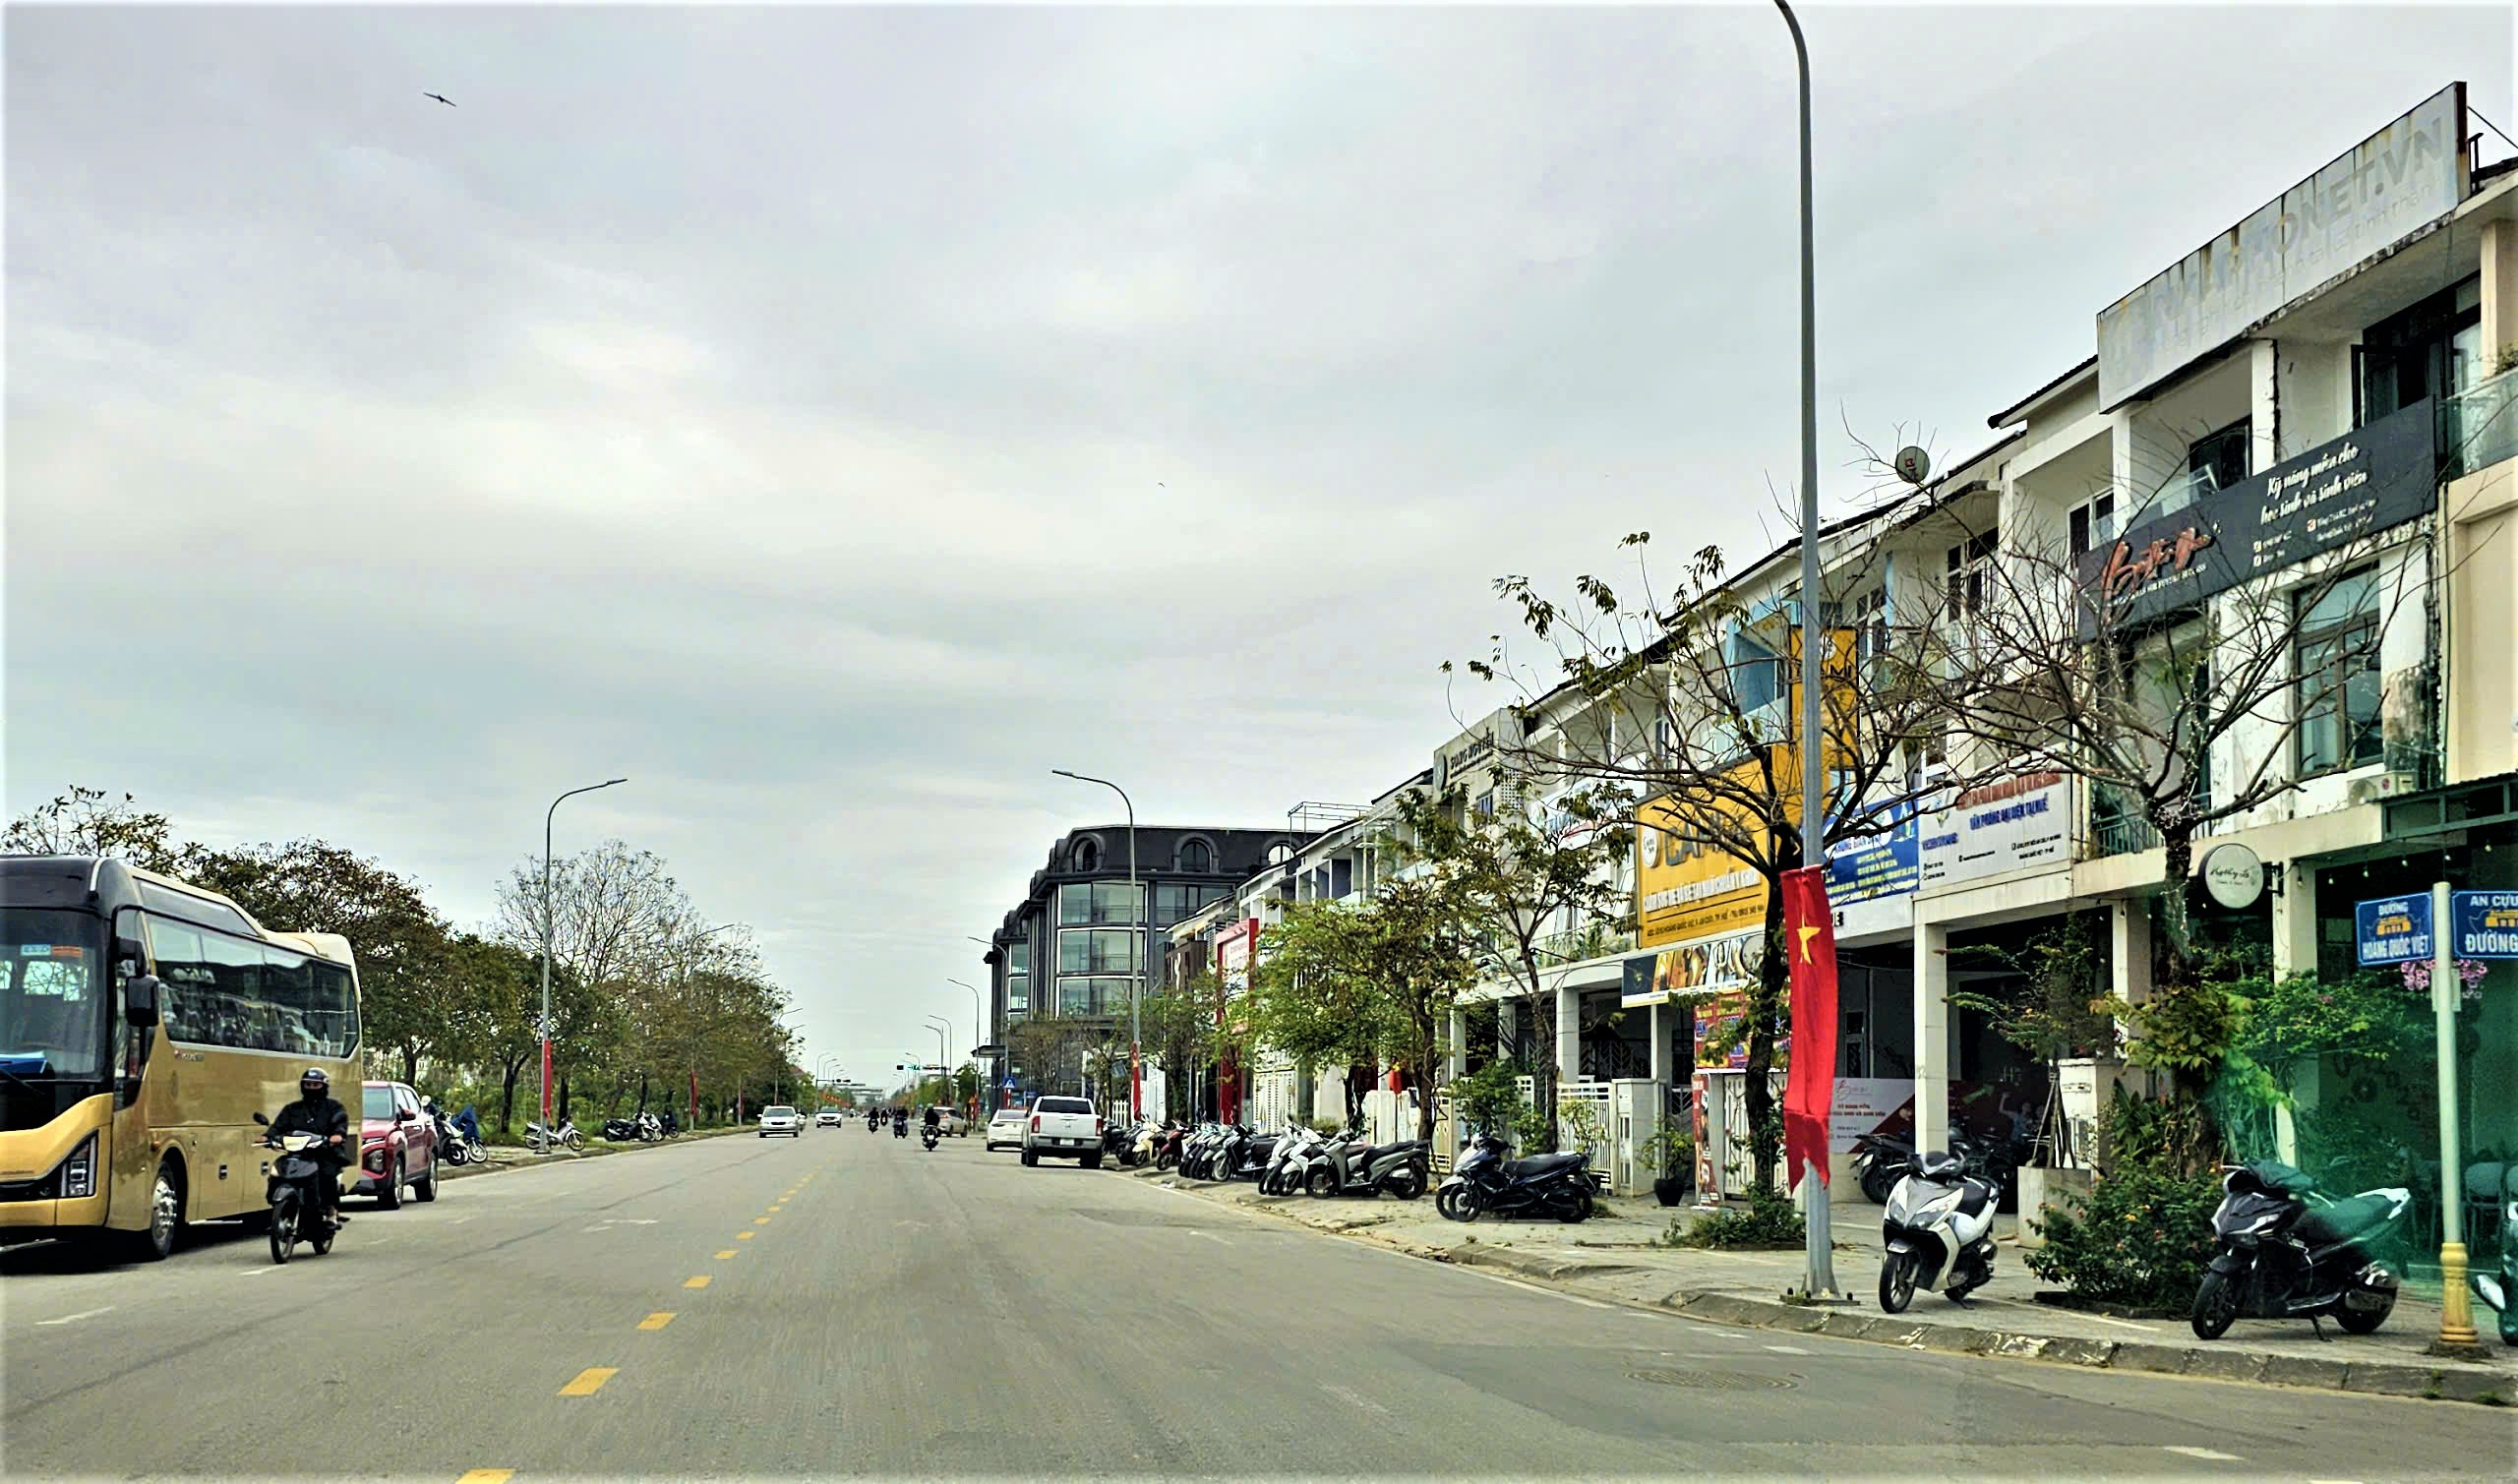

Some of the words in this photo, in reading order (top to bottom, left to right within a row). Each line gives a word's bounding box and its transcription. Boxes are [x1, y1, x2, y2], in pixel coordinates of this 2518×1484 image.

[2338, 442, 2360, 464] cho
[2470, 895, 2489, 906] AN
[2465, 928, 2518, 953] ĐƯỜNG
